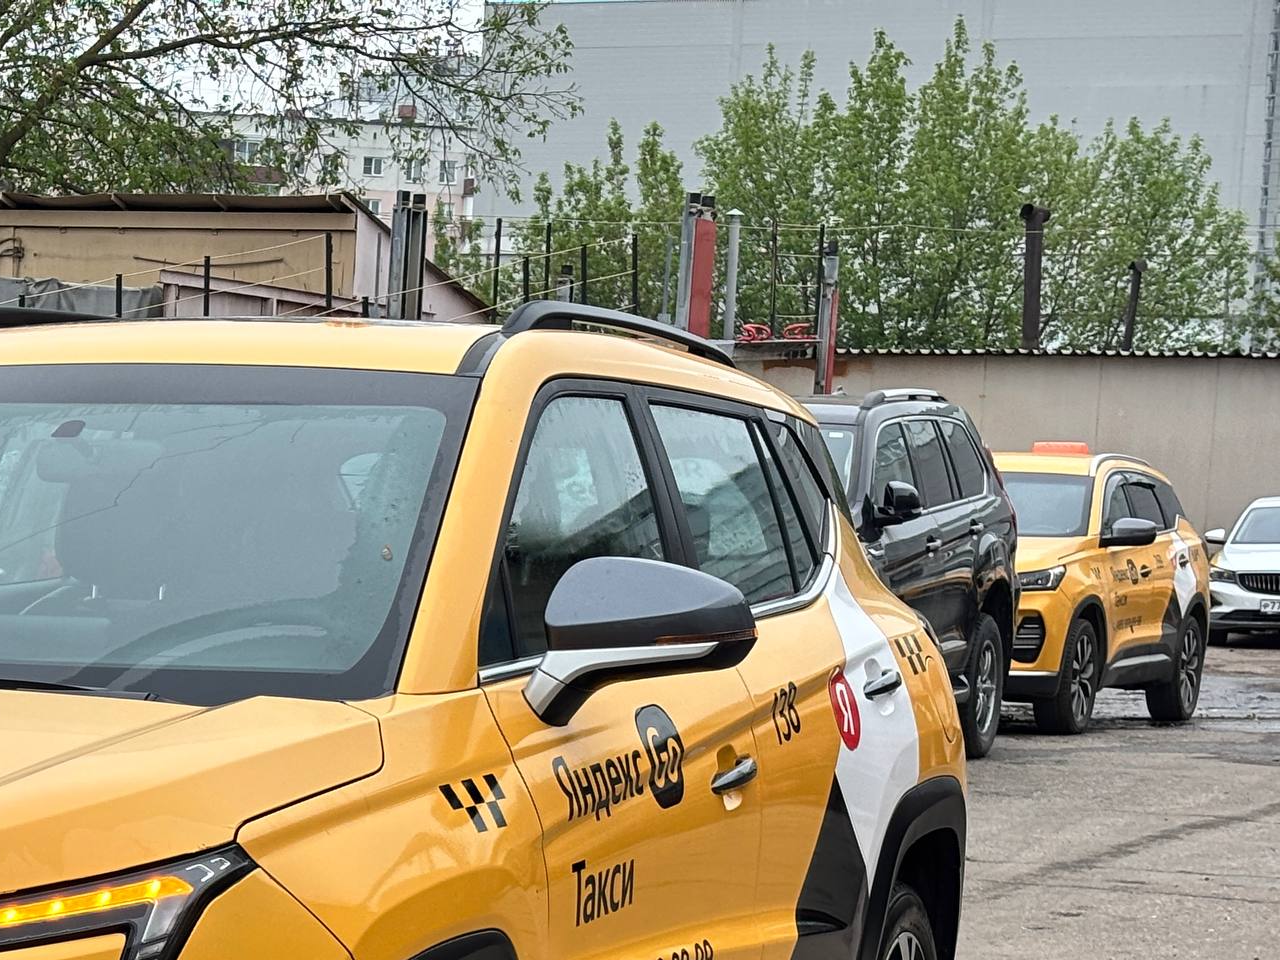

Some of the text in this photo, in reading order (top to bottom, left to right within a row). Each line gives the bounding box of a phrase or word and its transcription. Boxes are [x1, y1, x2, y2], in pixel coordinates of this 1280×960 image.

[771, 682, 801, 745] 138
[552, 726, 683, 822] Яндекс Go
[571, 858, 635, 927] Такси
